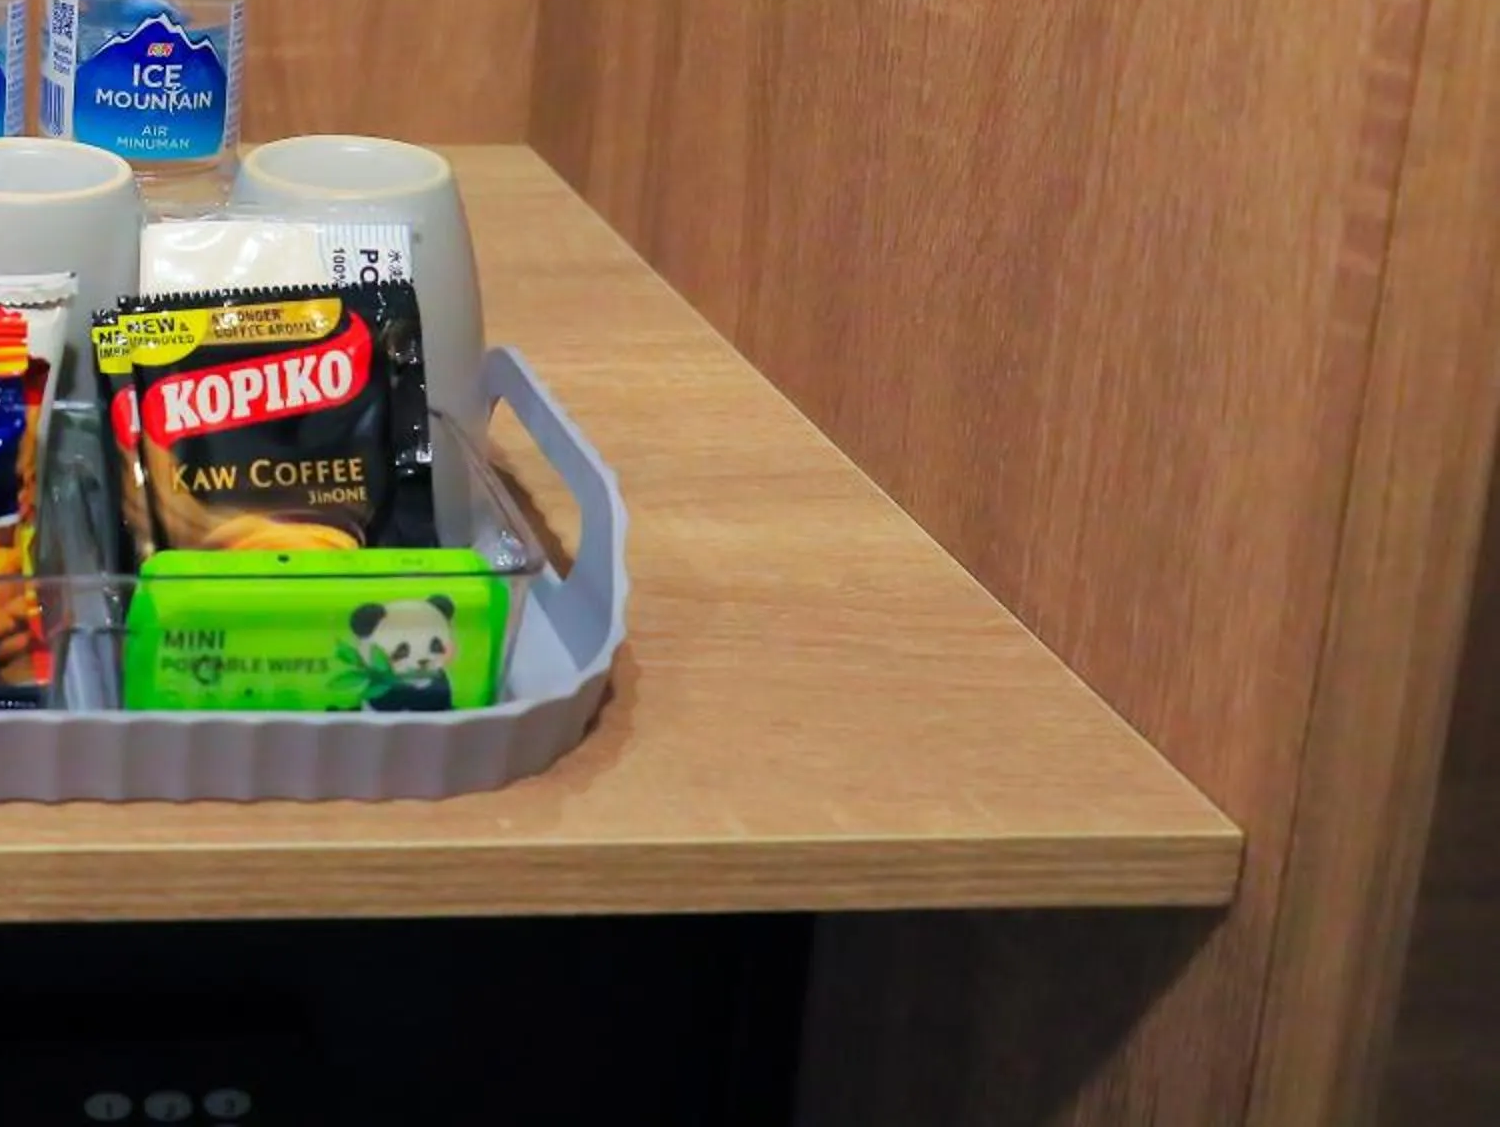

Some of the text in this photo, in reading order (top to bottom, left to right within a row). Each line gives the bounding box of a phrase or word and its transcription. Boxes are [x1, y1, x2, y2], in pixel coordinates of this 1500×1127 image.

[132, 63, 182, 88] ICE
[95, 87, 213, 113] MOUNTAIN
[142, 125, 168, 137] AIR
[116, 137, 190, 150] MINUMAN
[127, 317, 176, 336] NEW
[160, 349, 354, 435] KOPIKO
[171, 457, 364, 493] KAW COFFEE
[163, 629, 225, 650] MINI
[268, 657, 329, 673] WIPES
